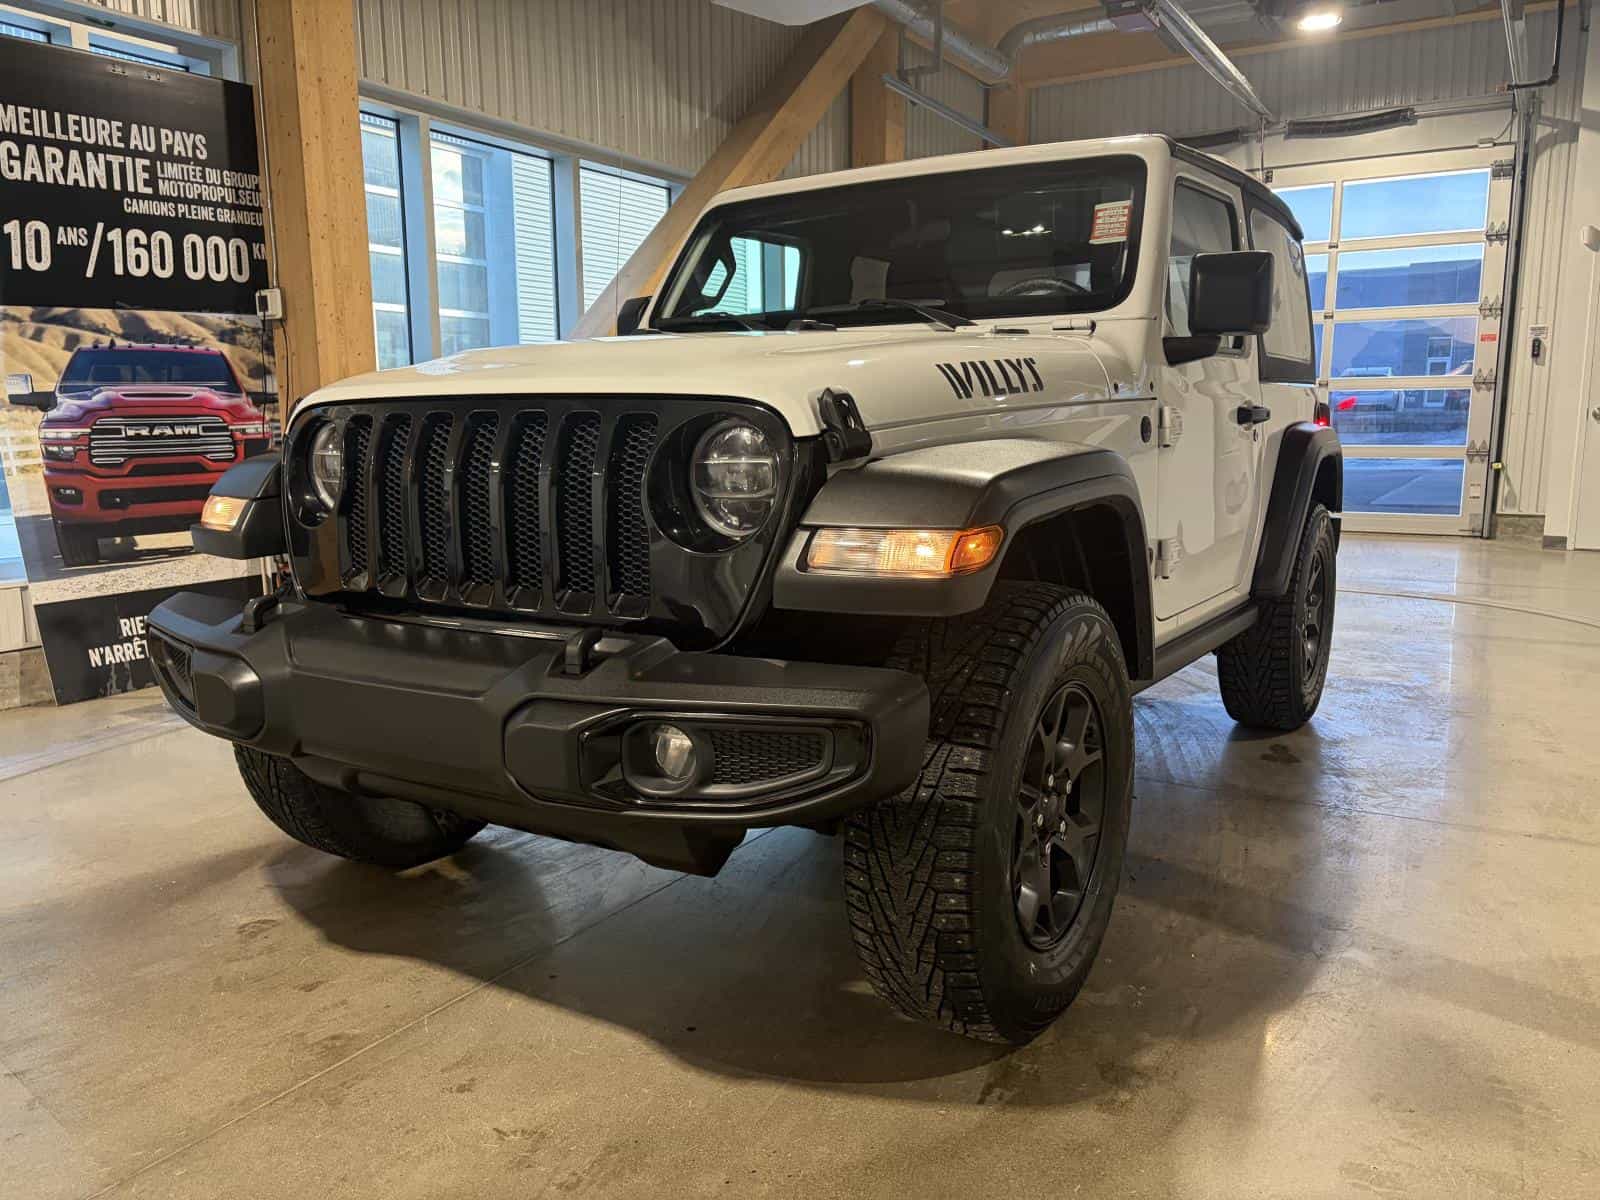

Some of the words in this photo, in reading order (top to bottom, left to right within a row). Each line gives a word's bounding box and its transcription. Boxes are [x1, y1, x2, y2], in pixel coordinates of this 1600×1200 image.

[0, 103, 125, 148] MEILLEURE
[129, 123, 156, 153] AU
[160, 128, 208, 160] PAYS
[0, 140, 153, 195] GARANTIE
[156, 160, 204, 183] LIMITÉE
[205, 167, 221, 185] DU
[223, 169, 259, 190] GROUP
[123, 197, 176, 218] CAMIONS
[177, 203, 217, 222] PLEINE
[216, 207, 263, 226] GRANDEU
[3, 219, 52, 272] 10
[56, 226, 89, 247] ANS
[183, 233, 250, 284] 000
[935, 357, 1045, 400] WILLYS
[126, 424, 199, 437] RAM
[120, 615, 148, 637] RIE
